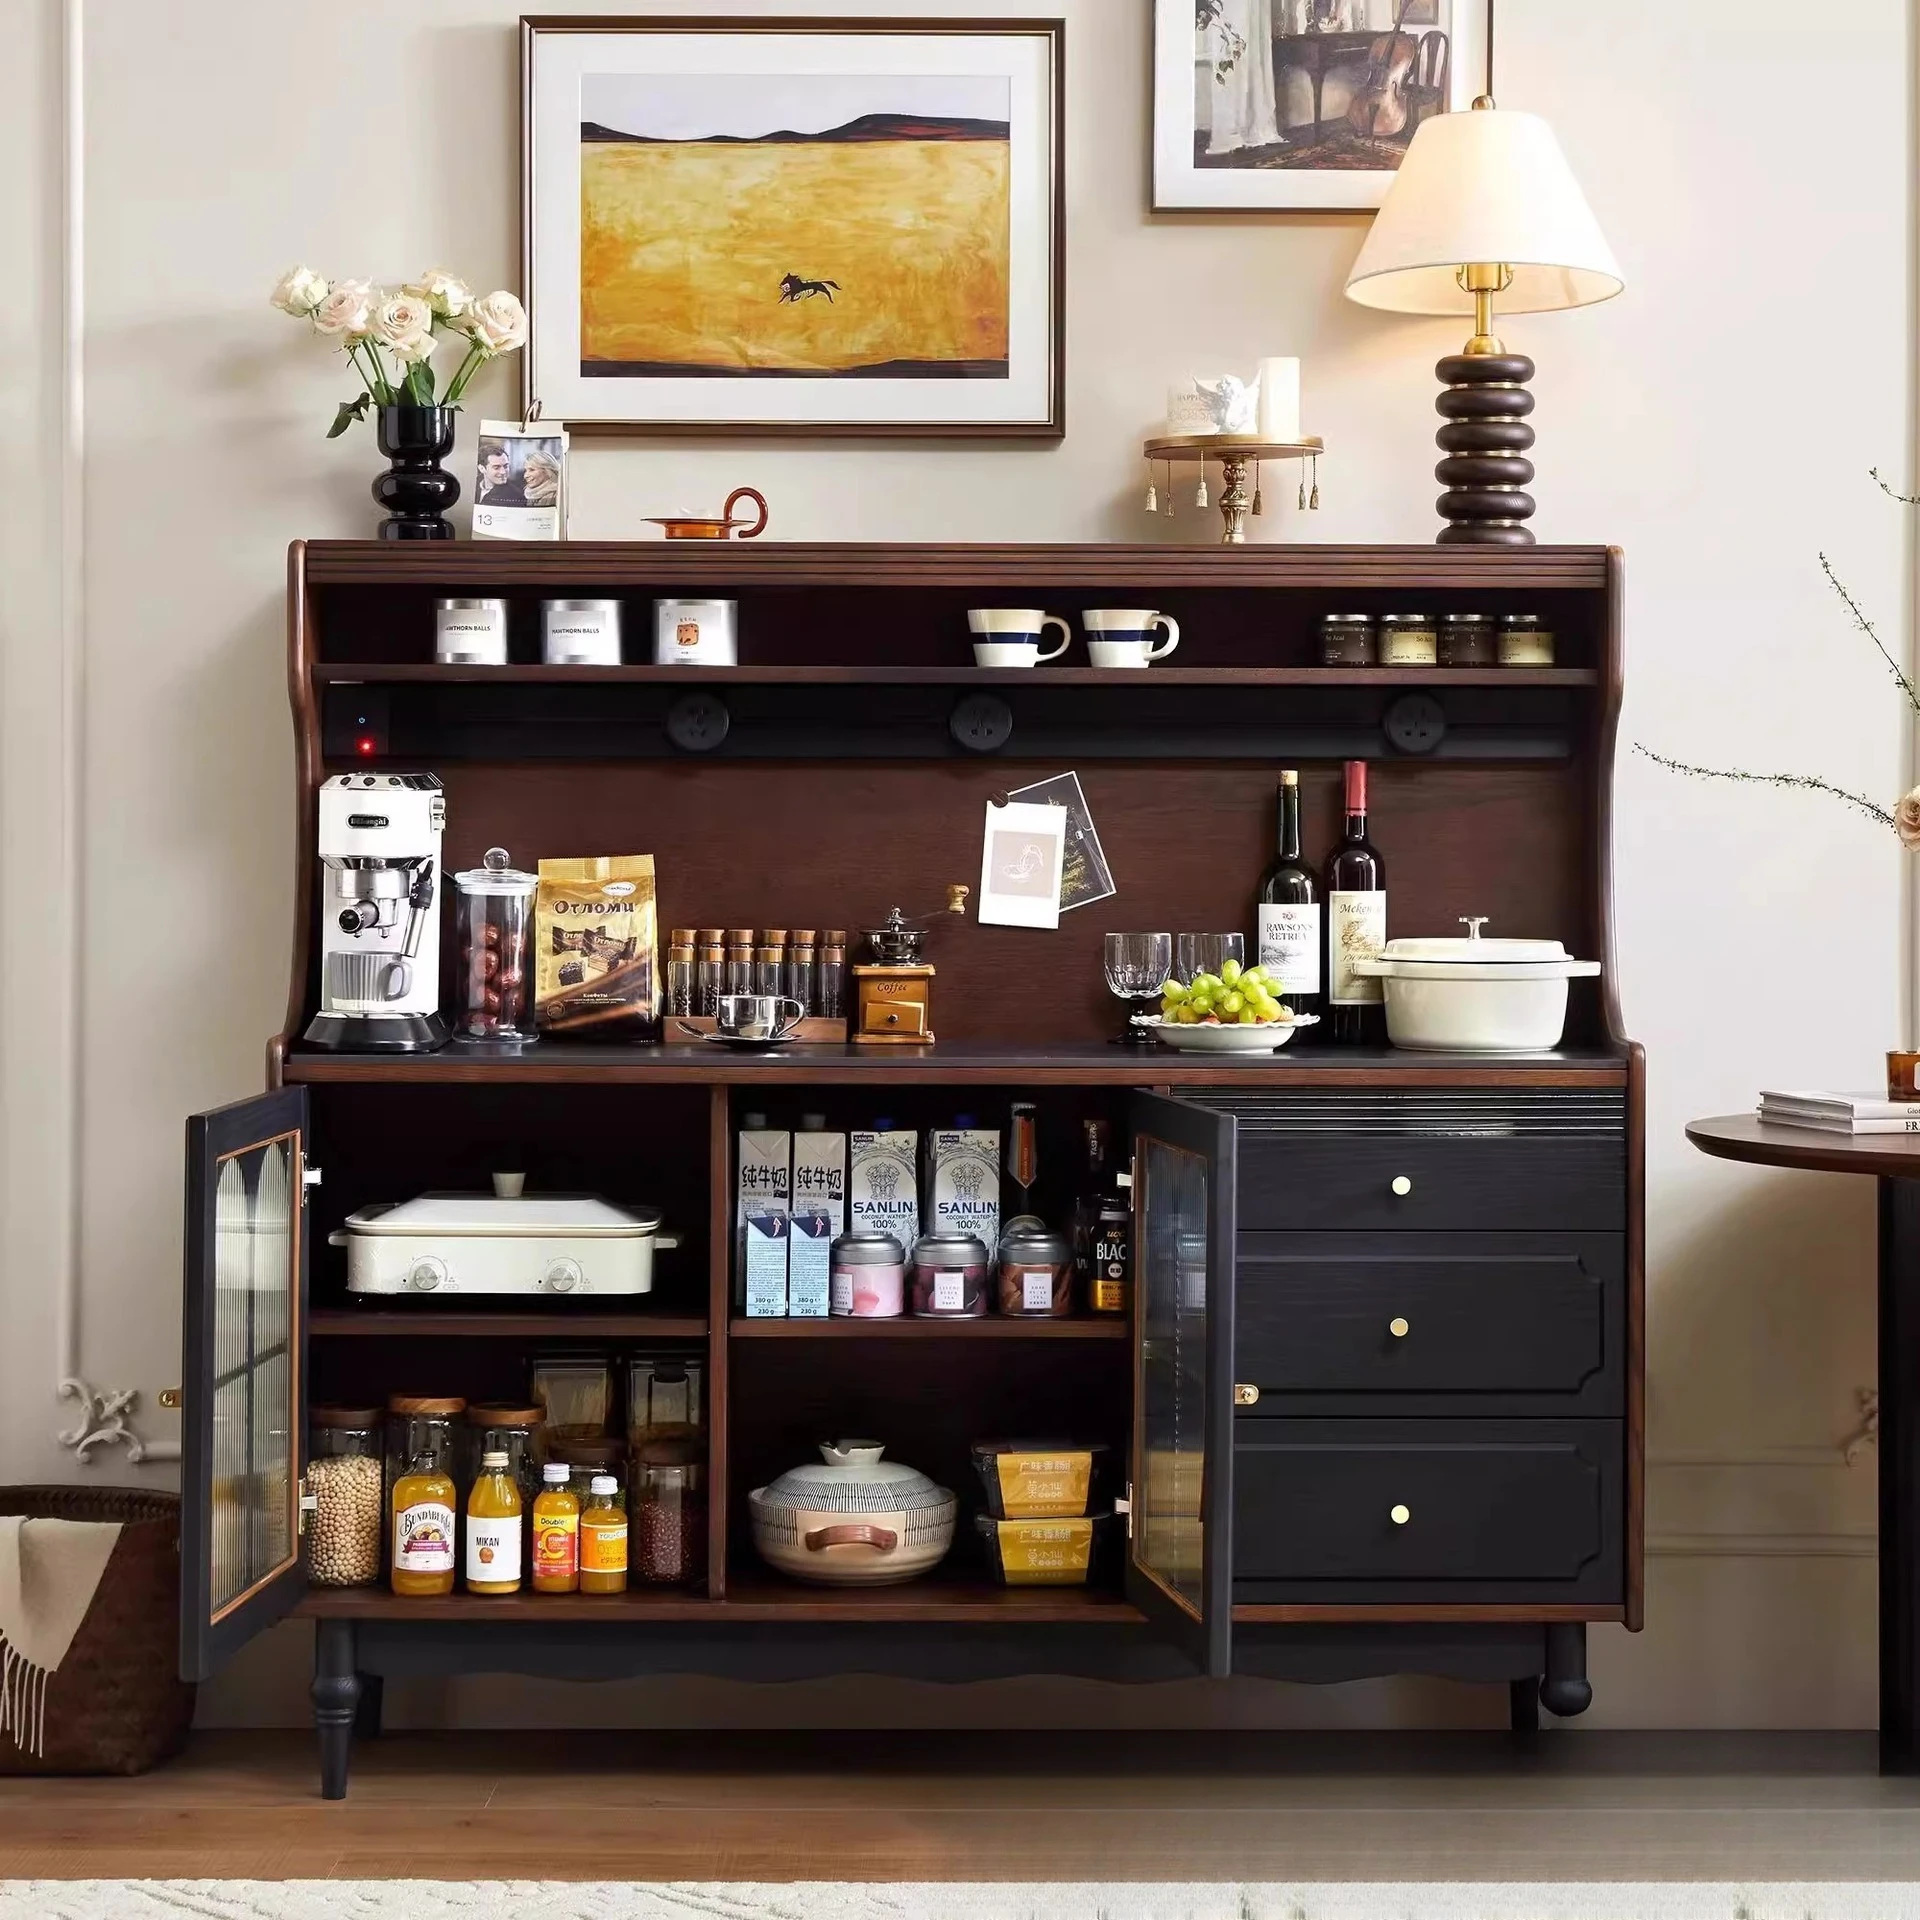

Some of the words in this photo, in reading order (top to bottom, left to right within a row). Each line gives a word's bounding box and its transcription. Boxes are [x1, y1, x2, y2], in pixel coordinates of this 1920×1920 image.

[477, 514, 493, 526] 13
[554, 900, 634, 914] Отломи
[877, 982, 907, 994] Coffee
[1905, 1121, 1920, 1131] FR
[741, 1164, 787, 1189] 纯牛奶
[797, 1165, 842, 1190] 纯牛奶
[853, 1201, 913, 1214] SANLIN
[938, 1201, 997, 1214] SANLIN
[871, 1219, 897, 1229] 100%
[956, 1219, 981, 1229] 100%
[1096, 1243, 1126, 1260] BLAC
[476, 1537, 499, 1546] MIKAN
